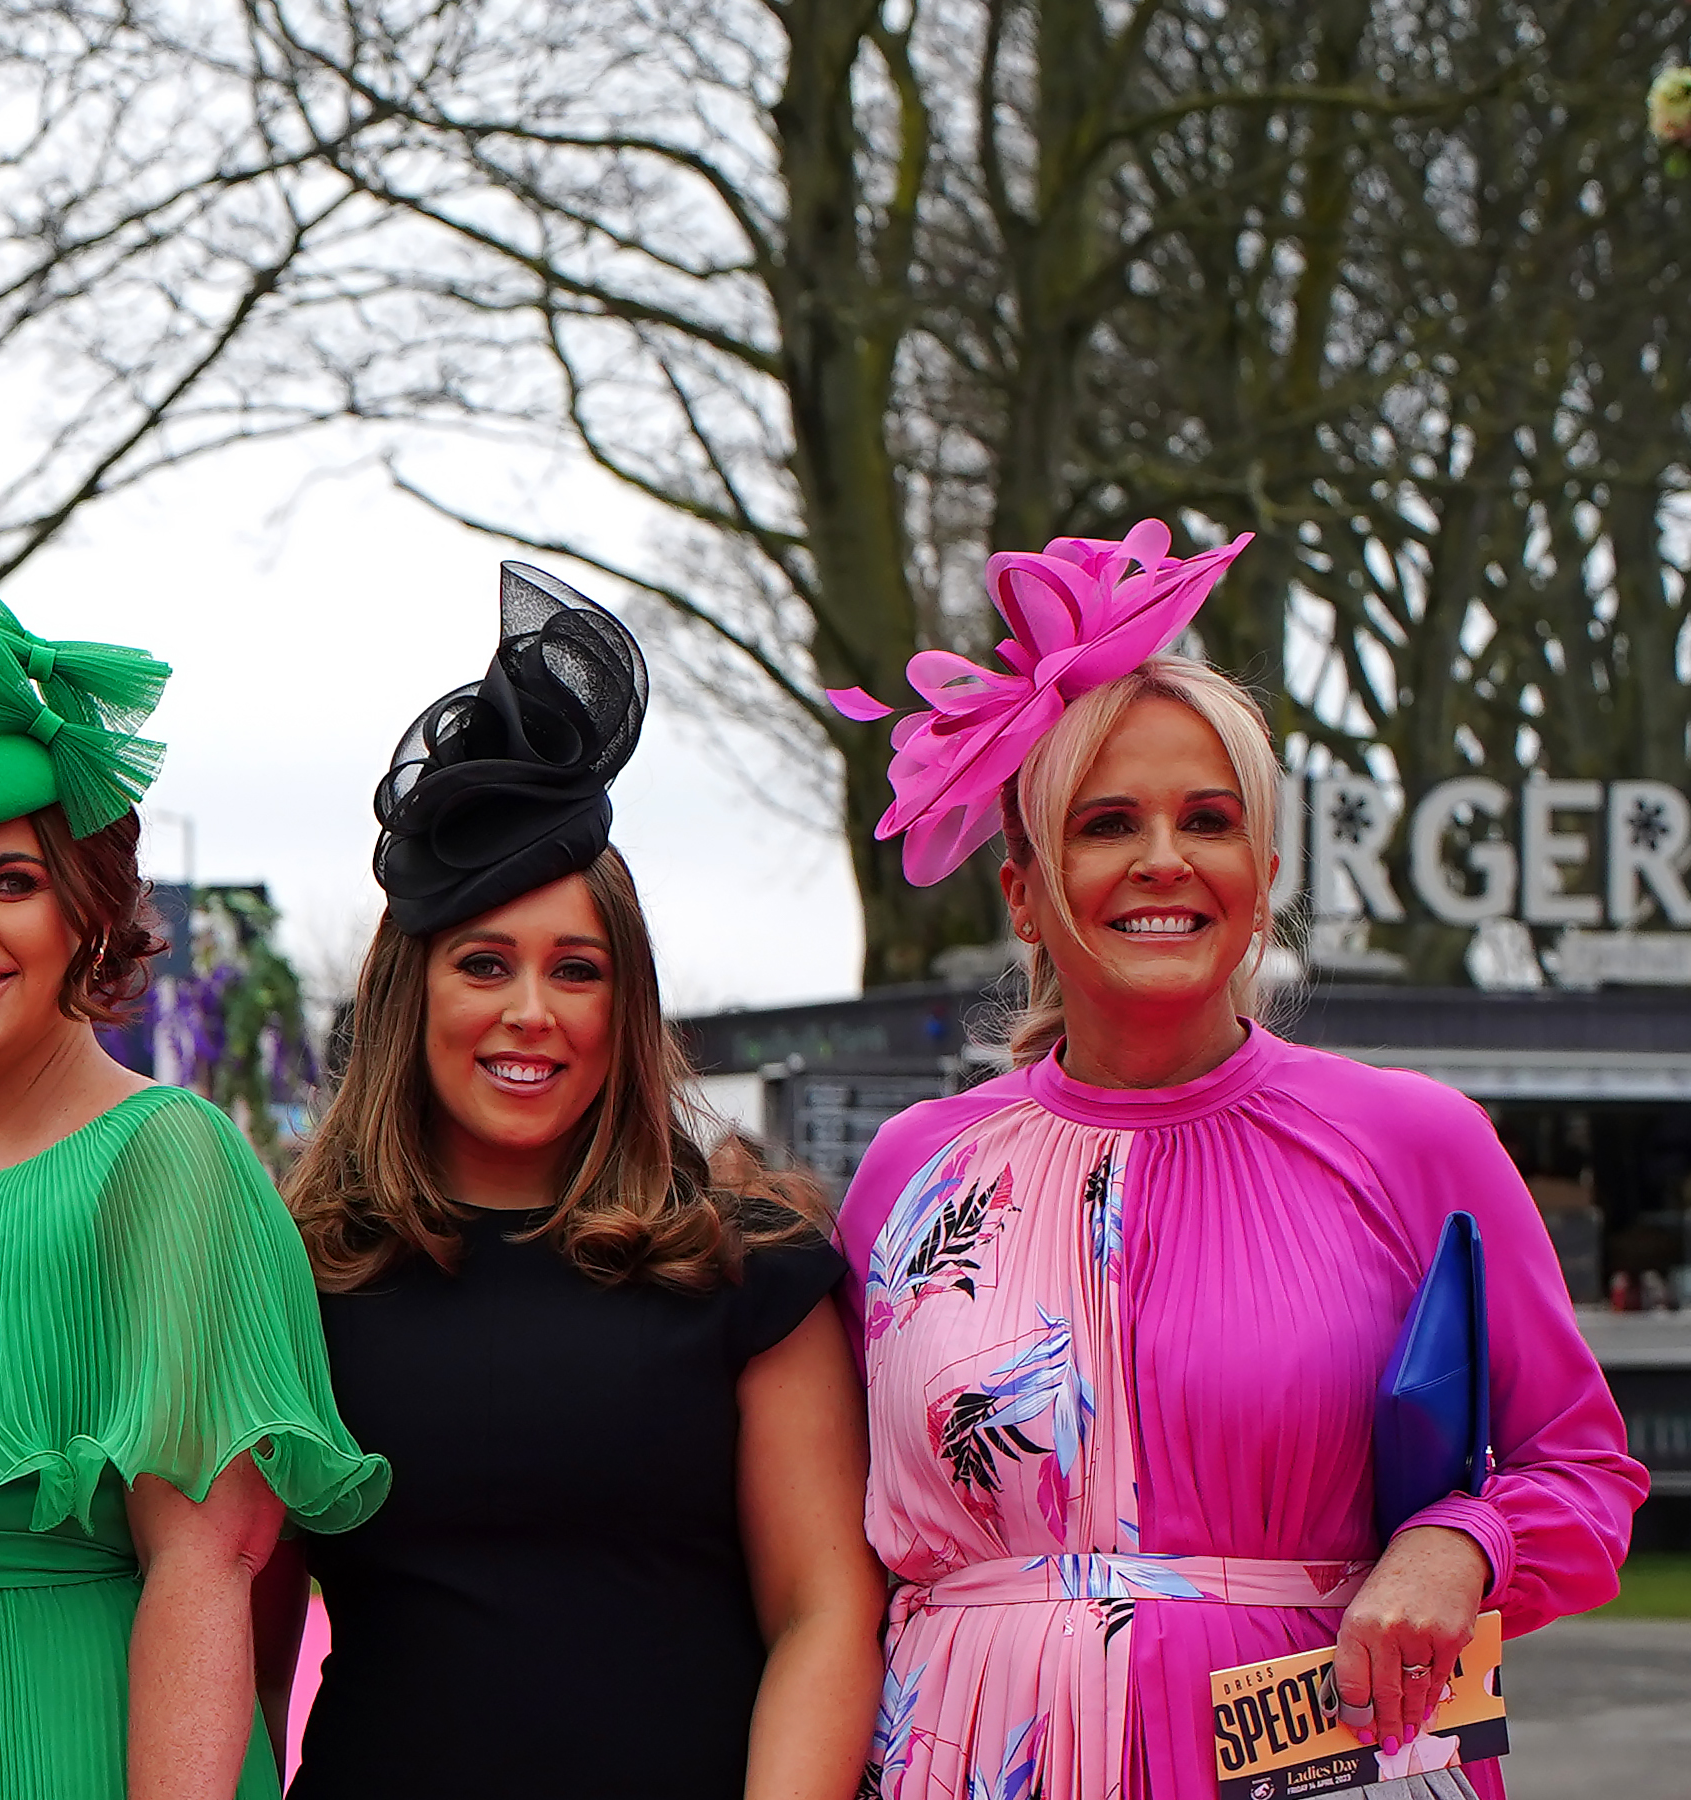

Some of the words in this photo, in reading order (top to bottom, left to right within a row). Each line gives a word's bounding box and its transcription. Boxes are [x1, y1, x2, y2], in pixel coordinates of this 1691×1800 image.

[1223, 1666, 1274, 1695] DRESS
[1287, 1765, 1331, 1785] Ladies
[1333, 1758, 1360, 1774] Day
